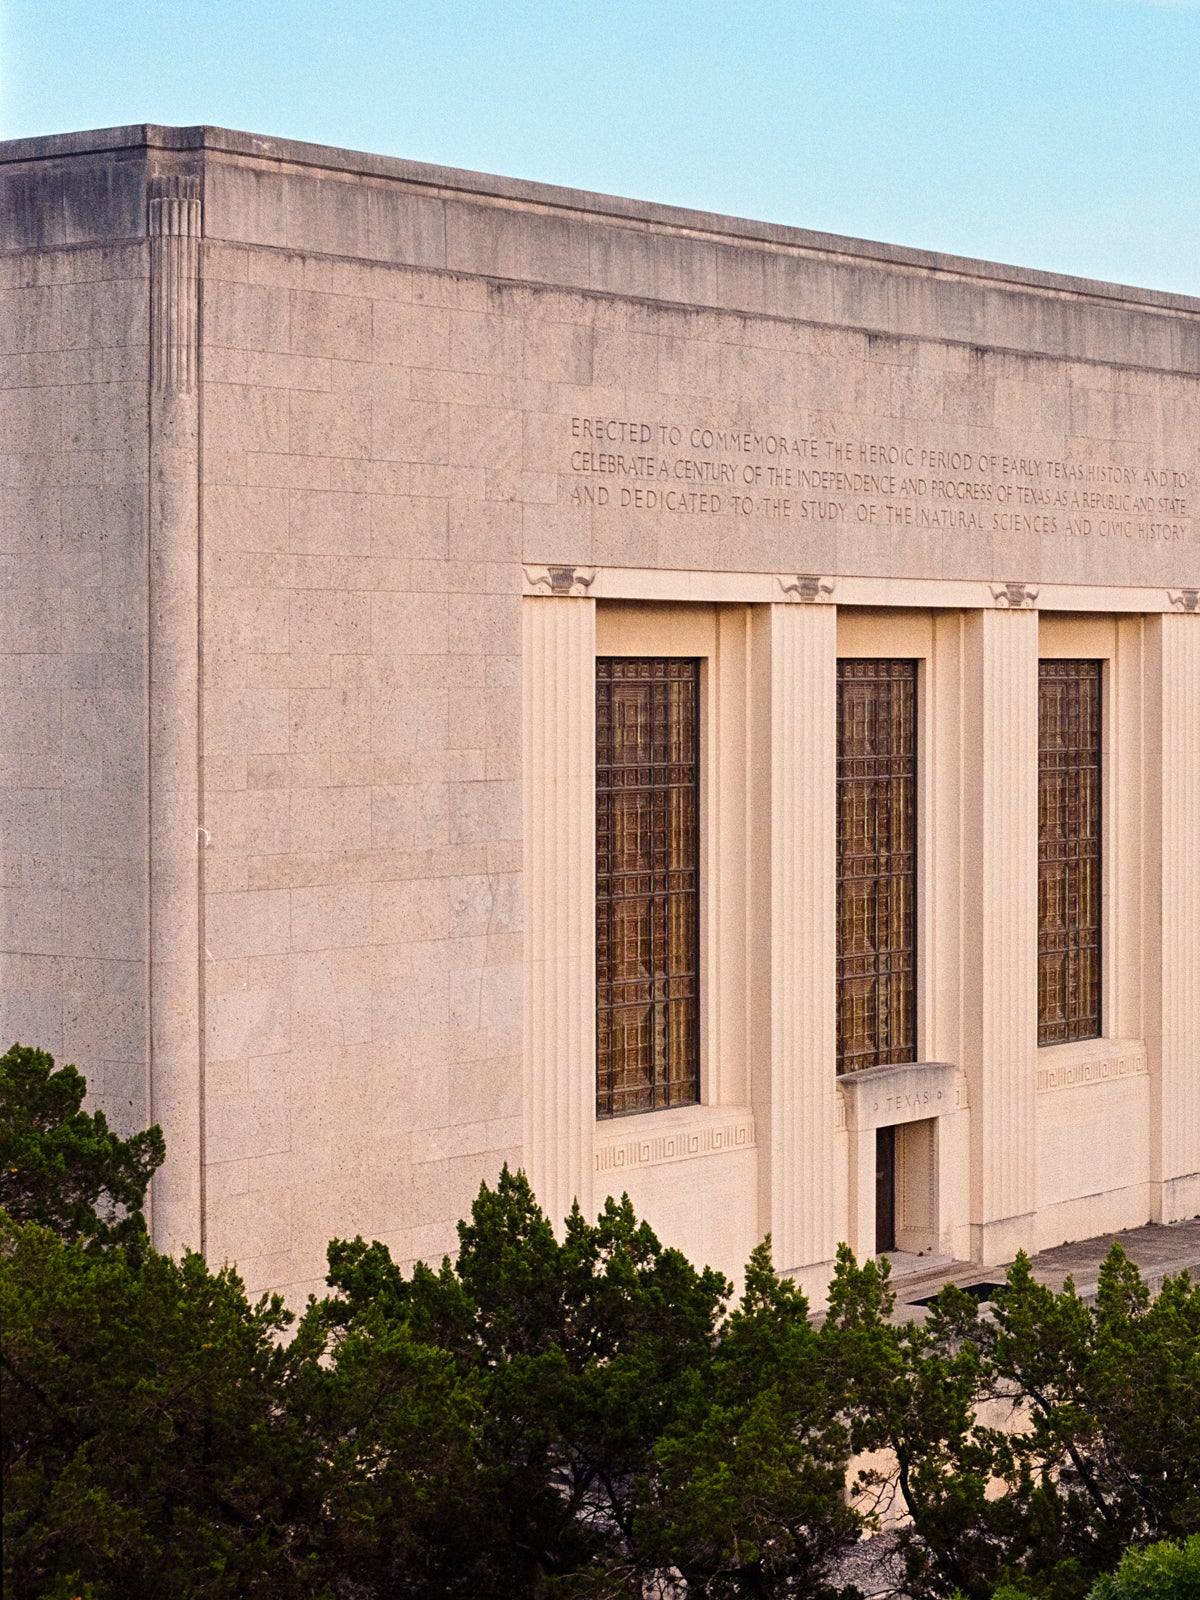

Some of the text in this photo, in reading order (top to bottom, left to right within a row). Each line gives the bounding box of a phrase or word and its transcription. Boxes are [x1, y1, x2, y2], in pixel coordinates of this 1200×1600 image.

[570, 450, 1186, 515] CELEBRATE A CENTURY OF THE INDEPENDENCE AND PROGRESS OF TEXAS AS A REPUBLIC AND STATE
[571, 417, 1187, 488] ERECTED TO COMMEMORATE THE HEROIC PERIOD OF EARLY TEXAS HISTORY AND TO
[570, 486, 1187, 541] AND DEDICATED TO THE STUDY OF THE NATURAL SCIENCES AND CIVIC HISTORY
[886, 1091, 928, 1112] TEXAS
